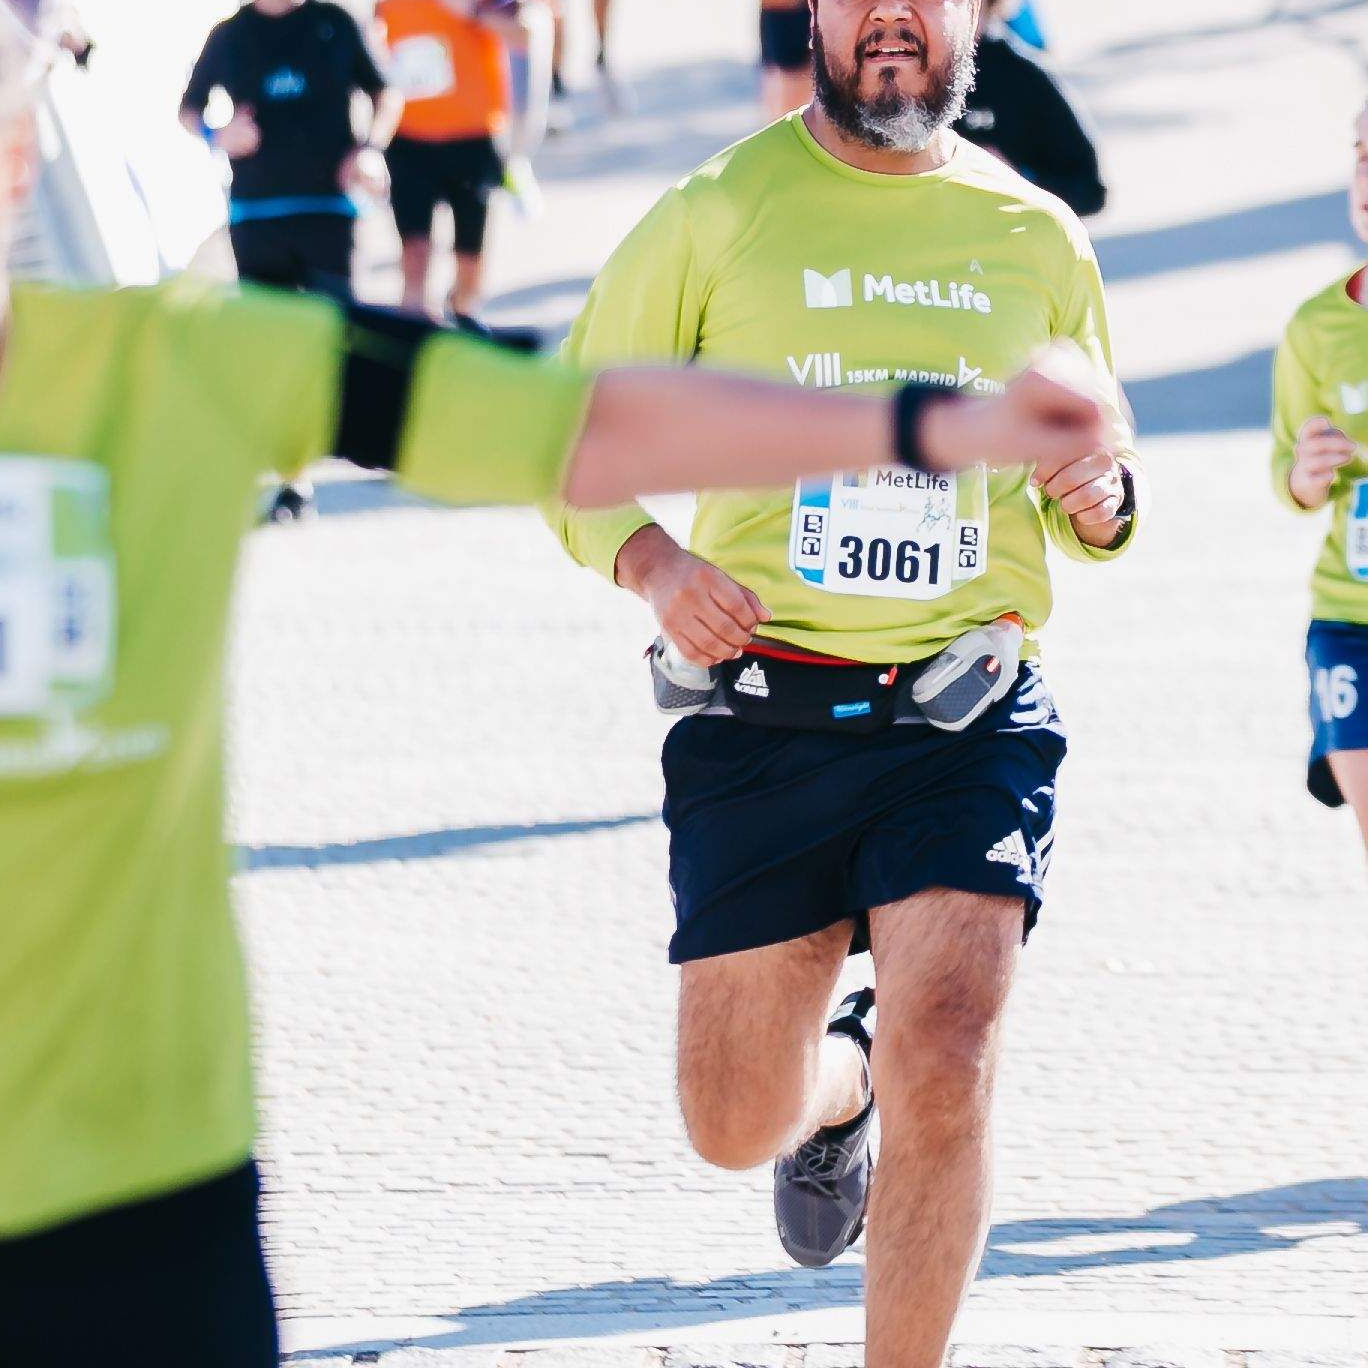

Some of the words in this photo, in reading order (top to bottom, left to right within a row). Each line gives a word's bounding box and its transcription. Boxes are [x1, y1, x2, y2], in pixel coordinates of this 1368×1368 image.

[863, 273, 992, 315] MetLife
[786, 352, 841, 388] VIII
[894, 368, 957, 388] MADRID
[875, 469, 950, 492] MetLife
[838, 535, 941, 585] 3061
